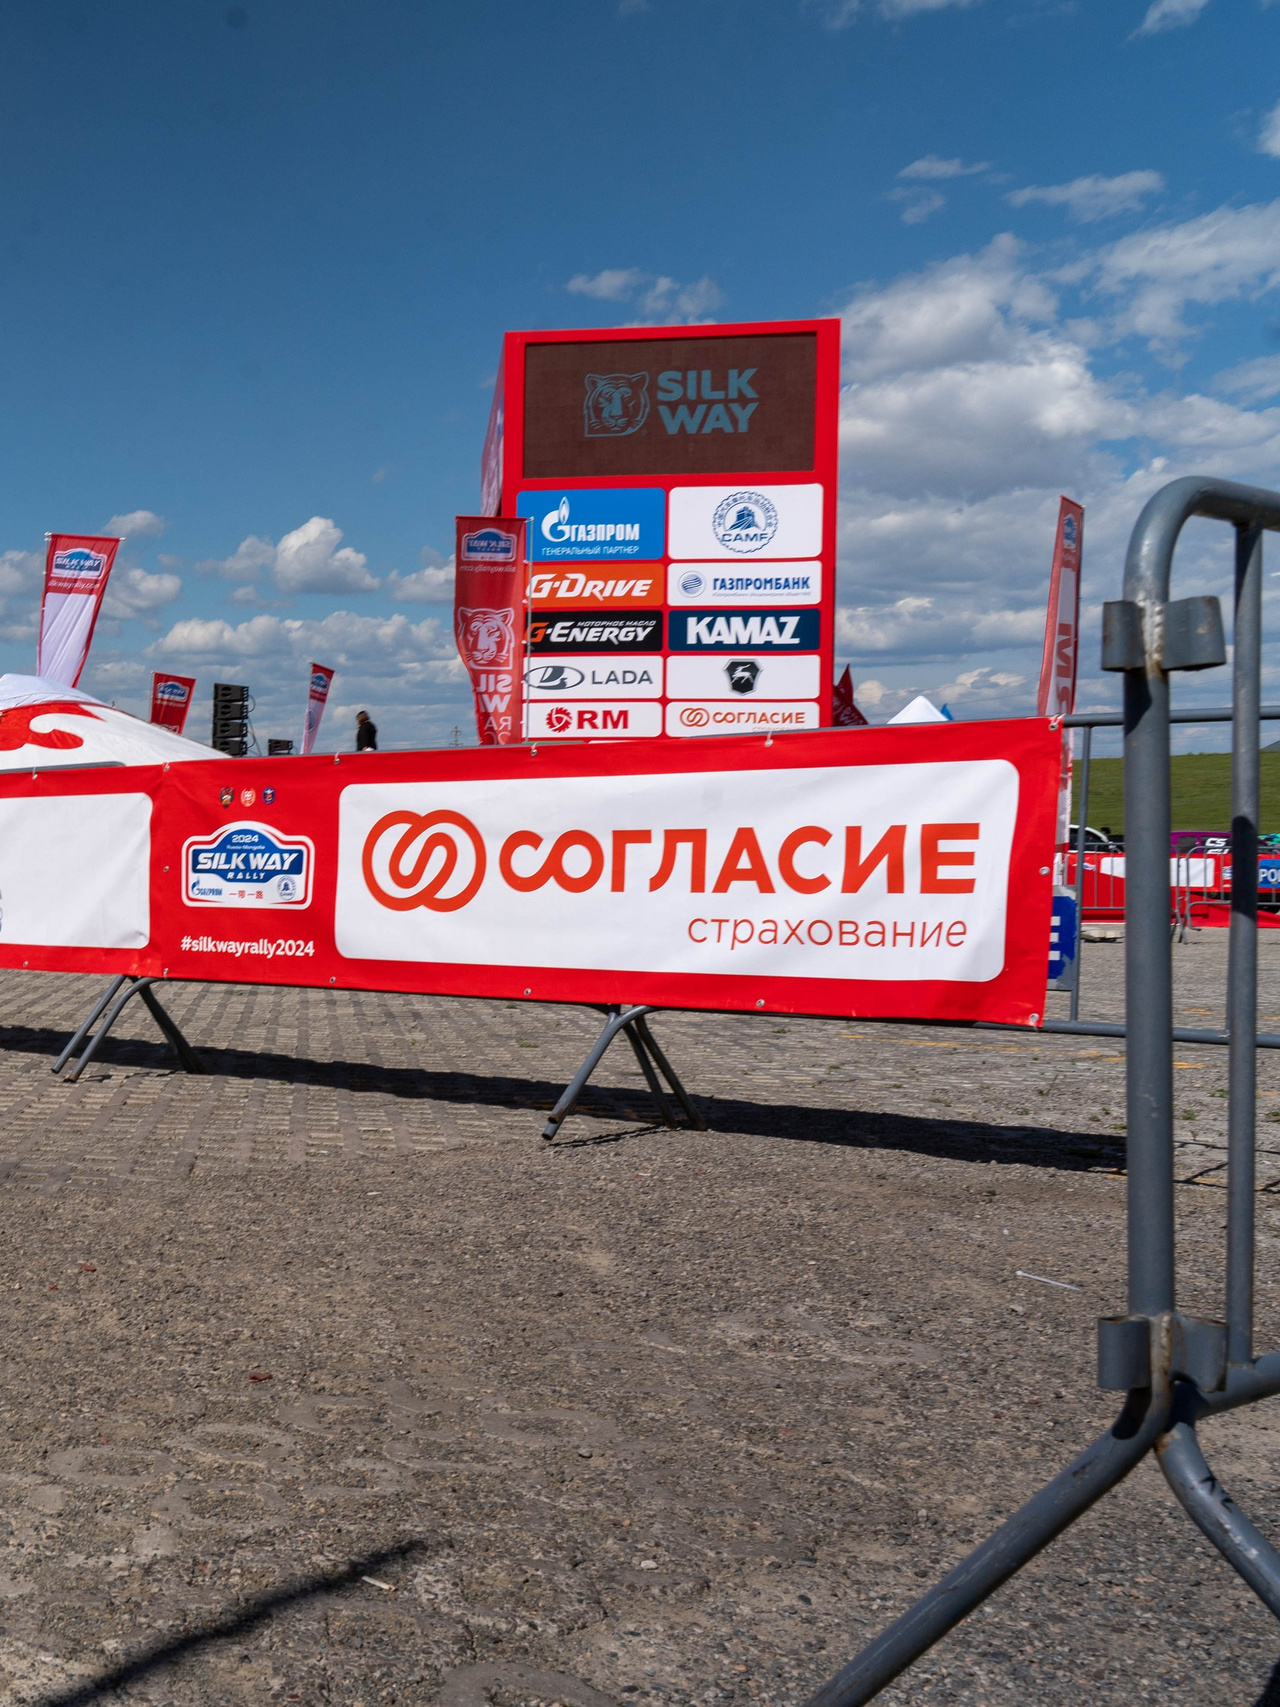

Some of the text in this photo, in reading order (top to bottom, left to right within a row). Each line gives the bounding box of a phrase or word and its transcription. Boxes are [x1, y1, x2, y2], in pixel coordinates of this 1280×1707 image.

[657, 368, 759, 401] SILK
[657, 402, 759, 435] WAY
[570, 523, 640, 542] ГАЗПРОМ
[721, 533, 769, 542] CAMF
[541, 545, 640, 556] ГЕНЕРАЛЬНЫЙ ПАРТНЕР
[712, 576, 811, 591] ГАЗПРОМБАНК
[686, 616, 801, 645] KAMAZ
[591, 670, 653, 685] LADA
[577, 710, 629, 729] RM
[712, 712, 806, 724] СОГЛАСИЕ
[232, 834, 259, 843] 2024
[1205, 838, 1228, 847] CS
[196, 852, 299, 871] SILK WAY
[499, 822, 980, 895] СОГЛАСИЕ
[226, 872, 266, 880] RALLY
[688, 917, 967, 950] страхование
[181, 935, 315, 958] #silkwayrally2024
